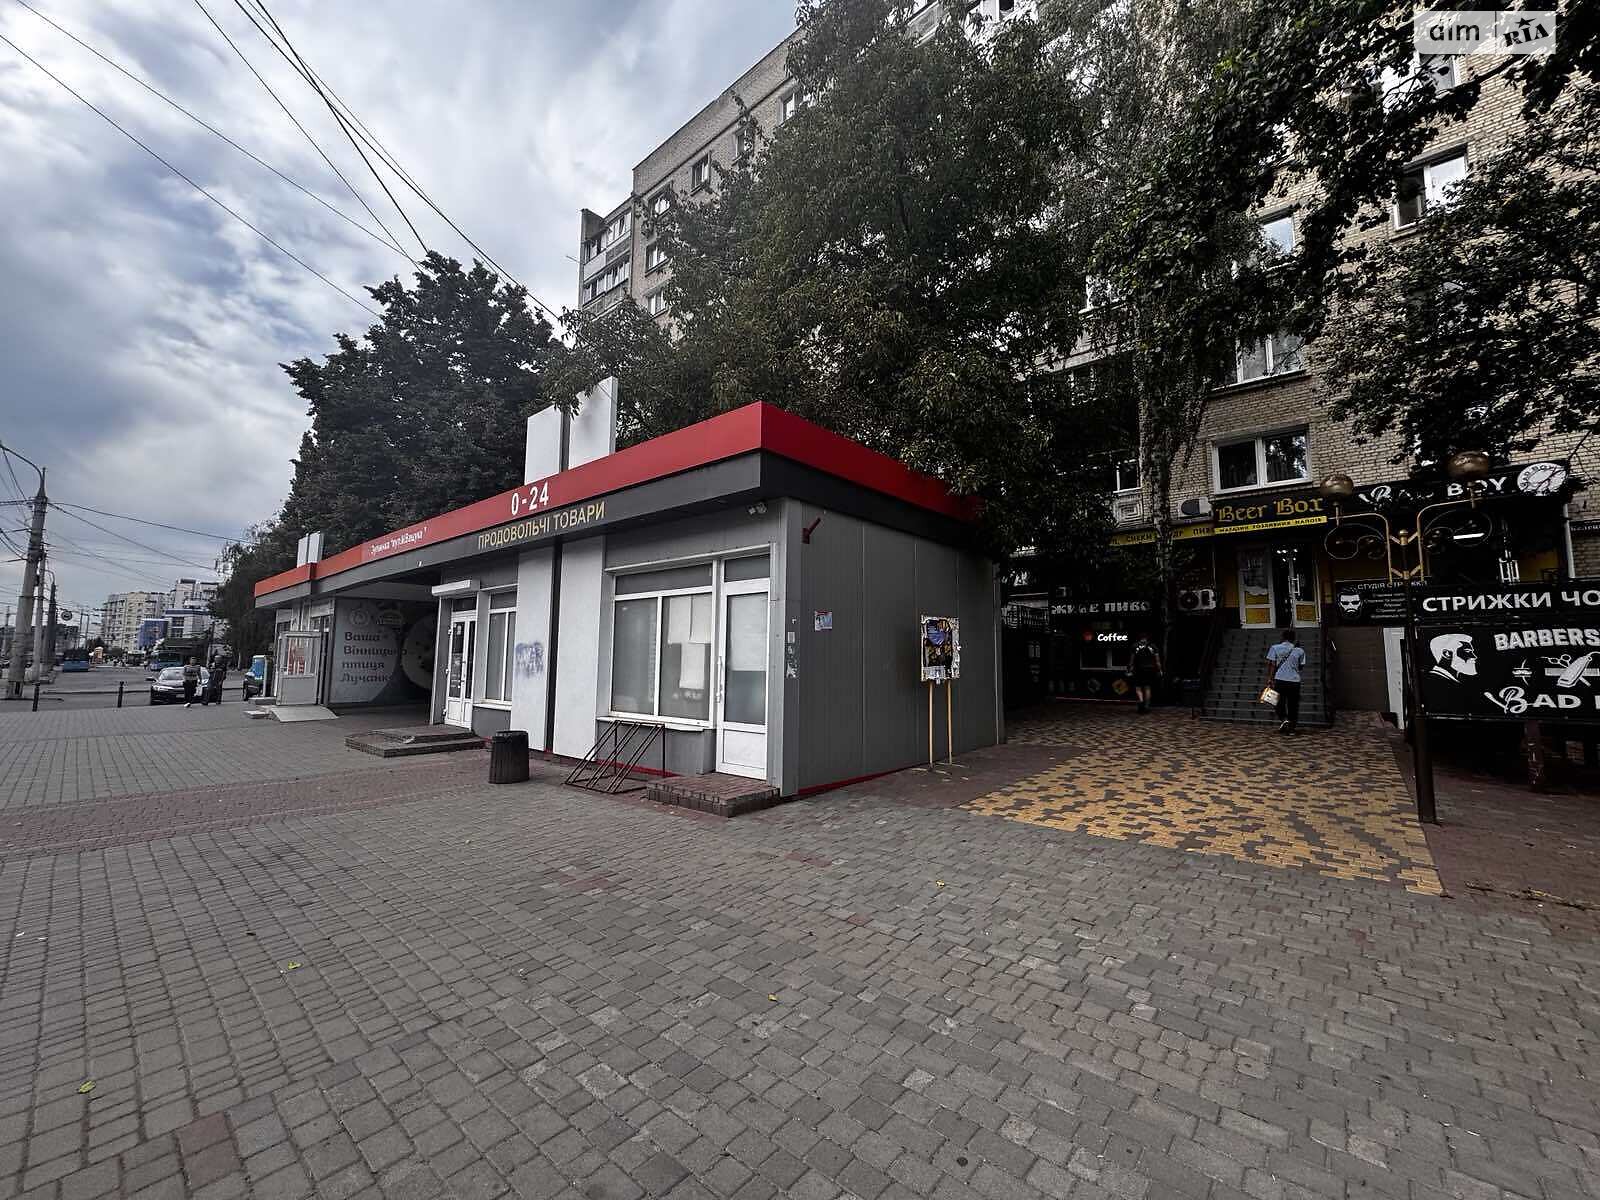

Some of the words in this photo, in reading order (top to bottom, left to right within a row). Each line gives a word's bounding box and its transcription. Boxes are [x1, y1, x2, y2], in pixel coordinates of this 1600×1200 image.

[1215, 505, 1268, 522] Beer
[1273, 497, 1324, 515] Box
[478, 518, 550, 550] ПРОДОВОЛЬЧІ
[554, 501, 605, 531] ТОВАРИ
[1422, 591, 1552, 612] СТРИЖКИ
[344, 631, 380, 642] Ваша
[1097, 633, 1128, 643] Coffee
[1484, 686, 1582, 714] BAD
